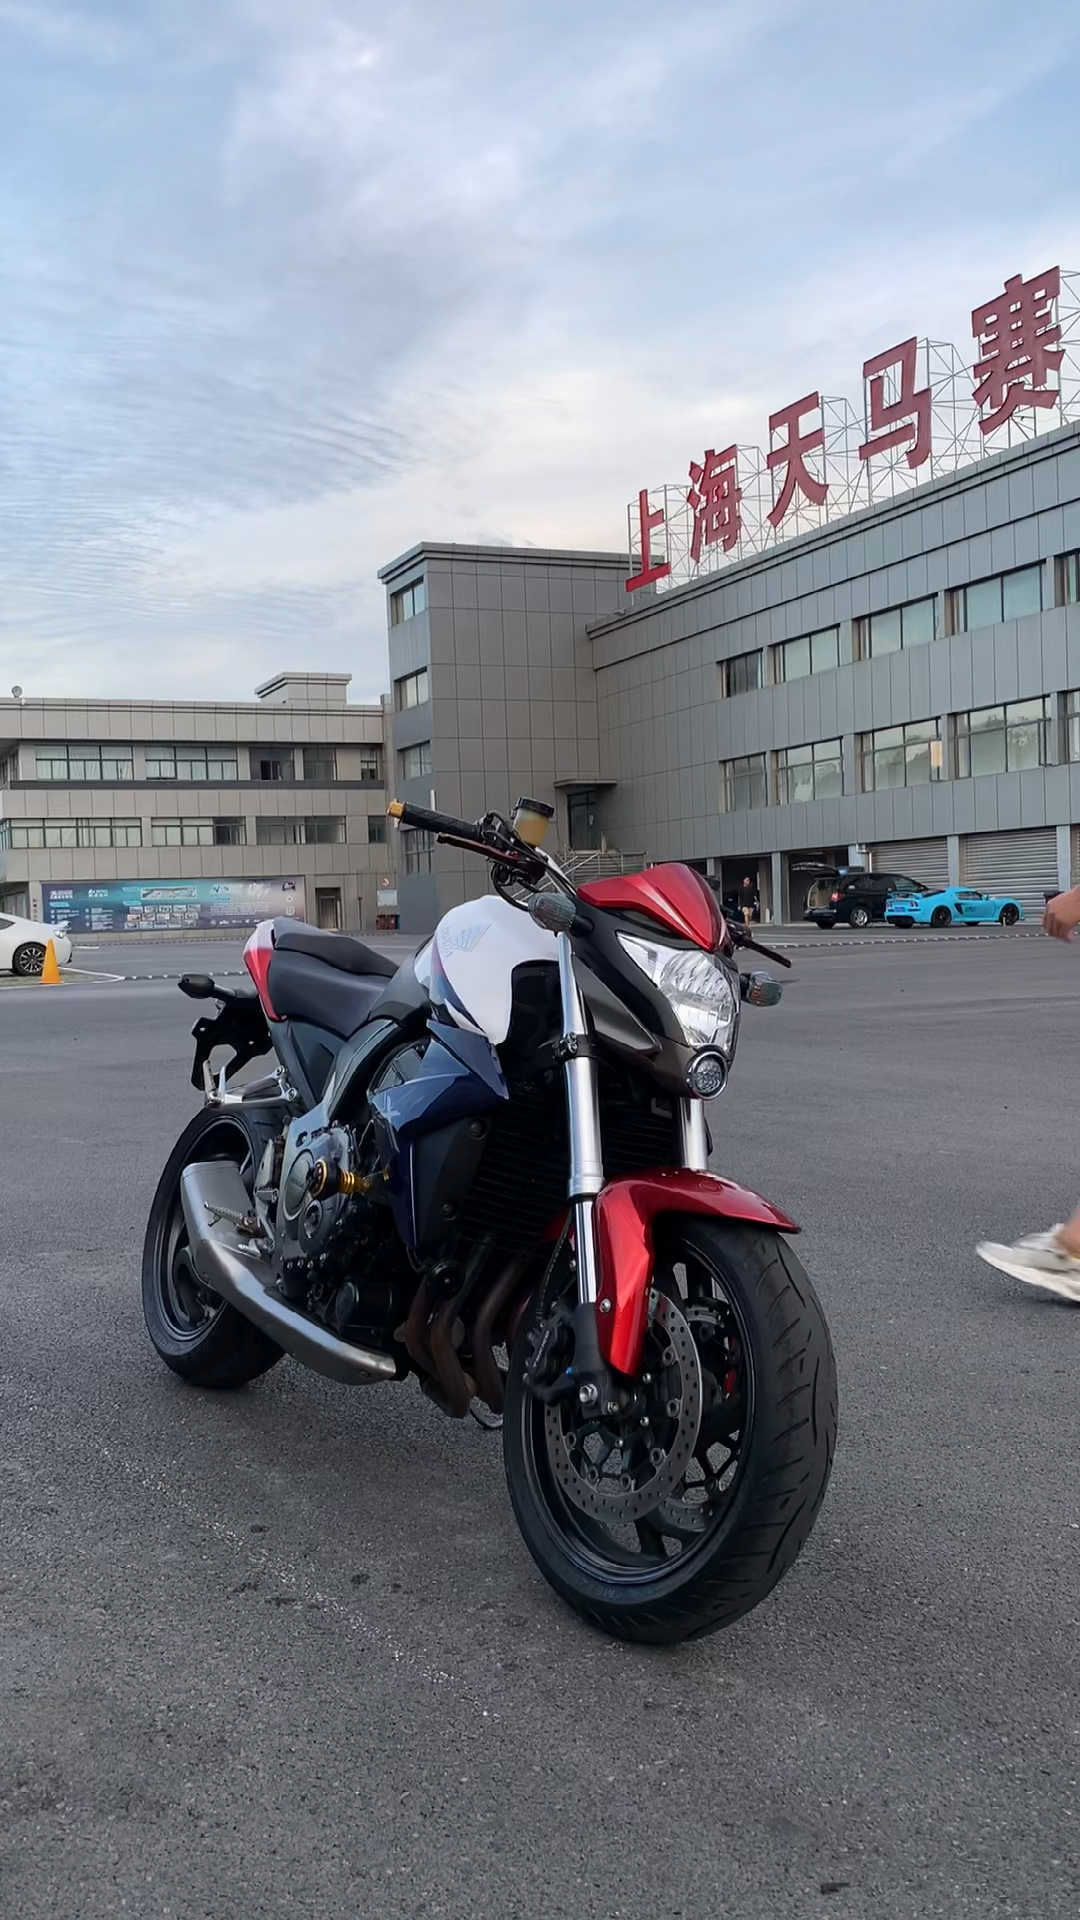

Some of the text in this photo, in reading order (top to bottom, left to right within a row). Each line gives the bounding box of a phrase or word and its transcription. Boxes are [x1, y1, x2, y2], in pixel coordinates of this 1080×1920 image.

[625, 265, 1067, 592] 上海天马赛
